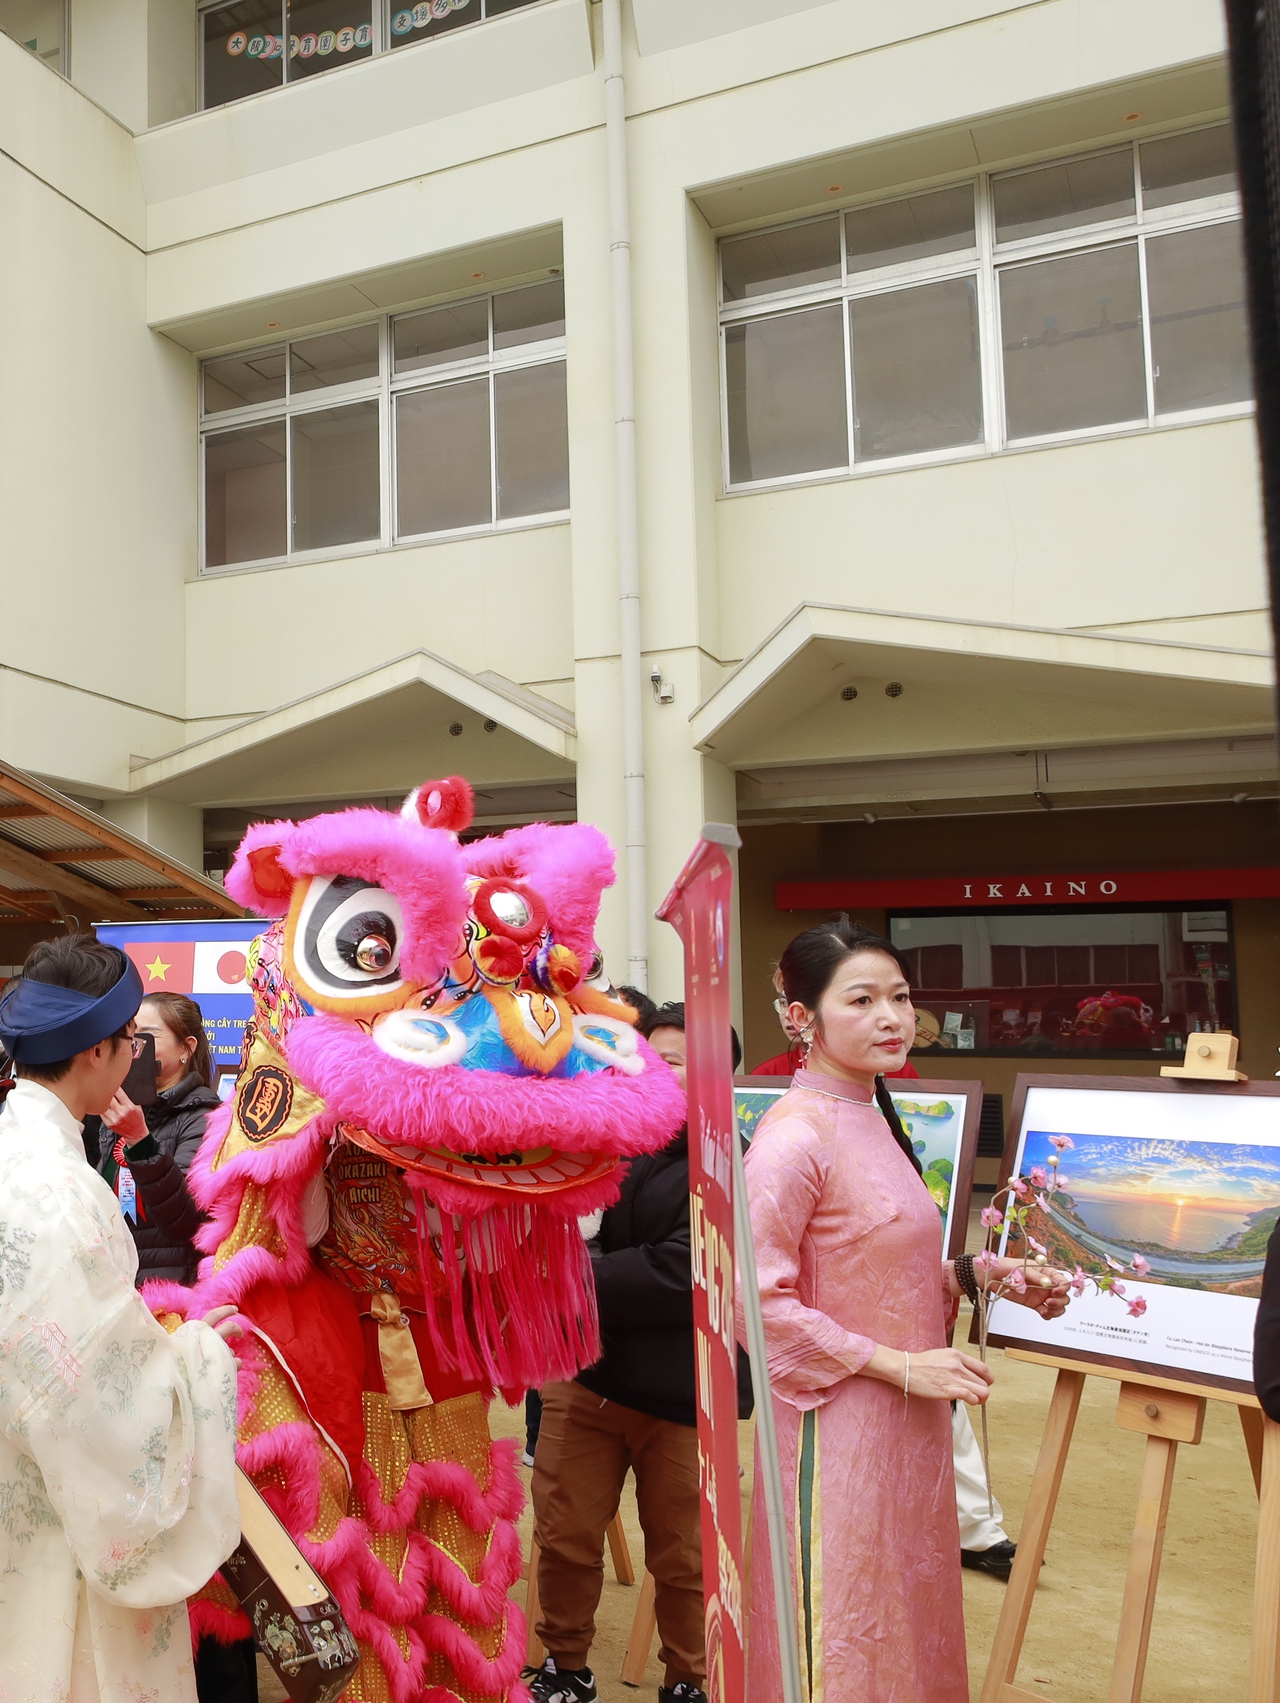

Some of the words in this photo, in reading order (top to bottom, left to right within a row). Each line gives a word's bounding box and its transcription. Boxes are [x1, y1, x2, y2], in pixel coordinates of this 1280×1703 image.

[964, 880, 1118, 898] IKAINO
[217, 1016, 232, 1028] CÂY
[218, 1045, 236, 1054] NAM
[349, 1187, 380, 1204] AICHI
